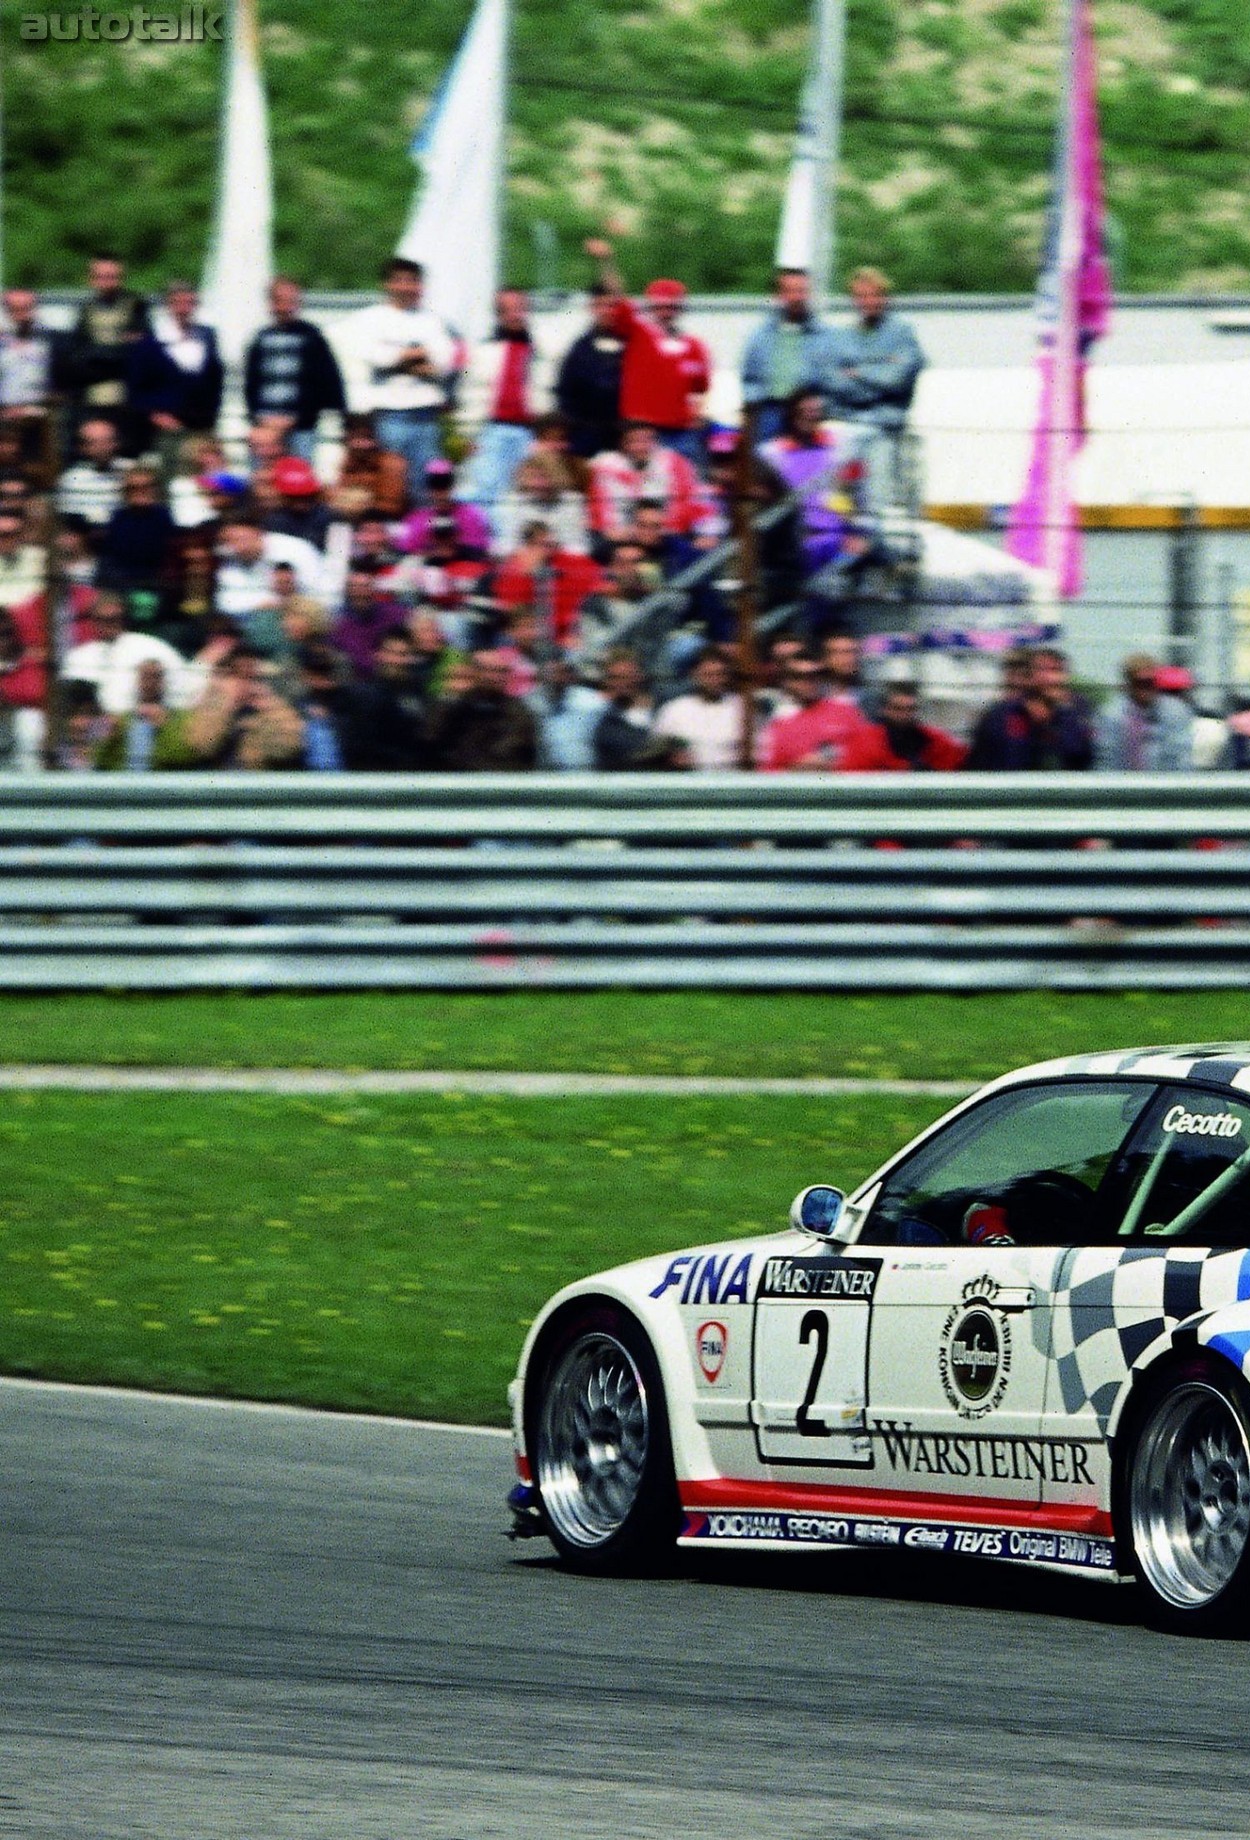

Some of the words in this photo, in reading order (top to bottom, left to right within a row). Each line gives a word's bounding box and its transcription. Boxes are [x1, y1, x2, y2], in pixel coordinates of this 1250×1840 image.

[1162, 1104, 1242, 1137] Cecotto
[648, 1253, 754, 1305] FINA
[764, 1259, 876, 1296] WARSTEINER
[795, 1309, 832, 1437] 2
[872, 1419, 1096, 1485] WARSTEINER
[707, 1514, 785, 1538] YOKOHAMA
[787, 1517, 850, 1541] RECARO
[953, 1530, 1004, 1555] TEVES
[1009, 1531, 1057, 1560] Original
[1058, 1536, 1088, 1562] BMW
[1089, 1541, 1114, 1566] Teile
